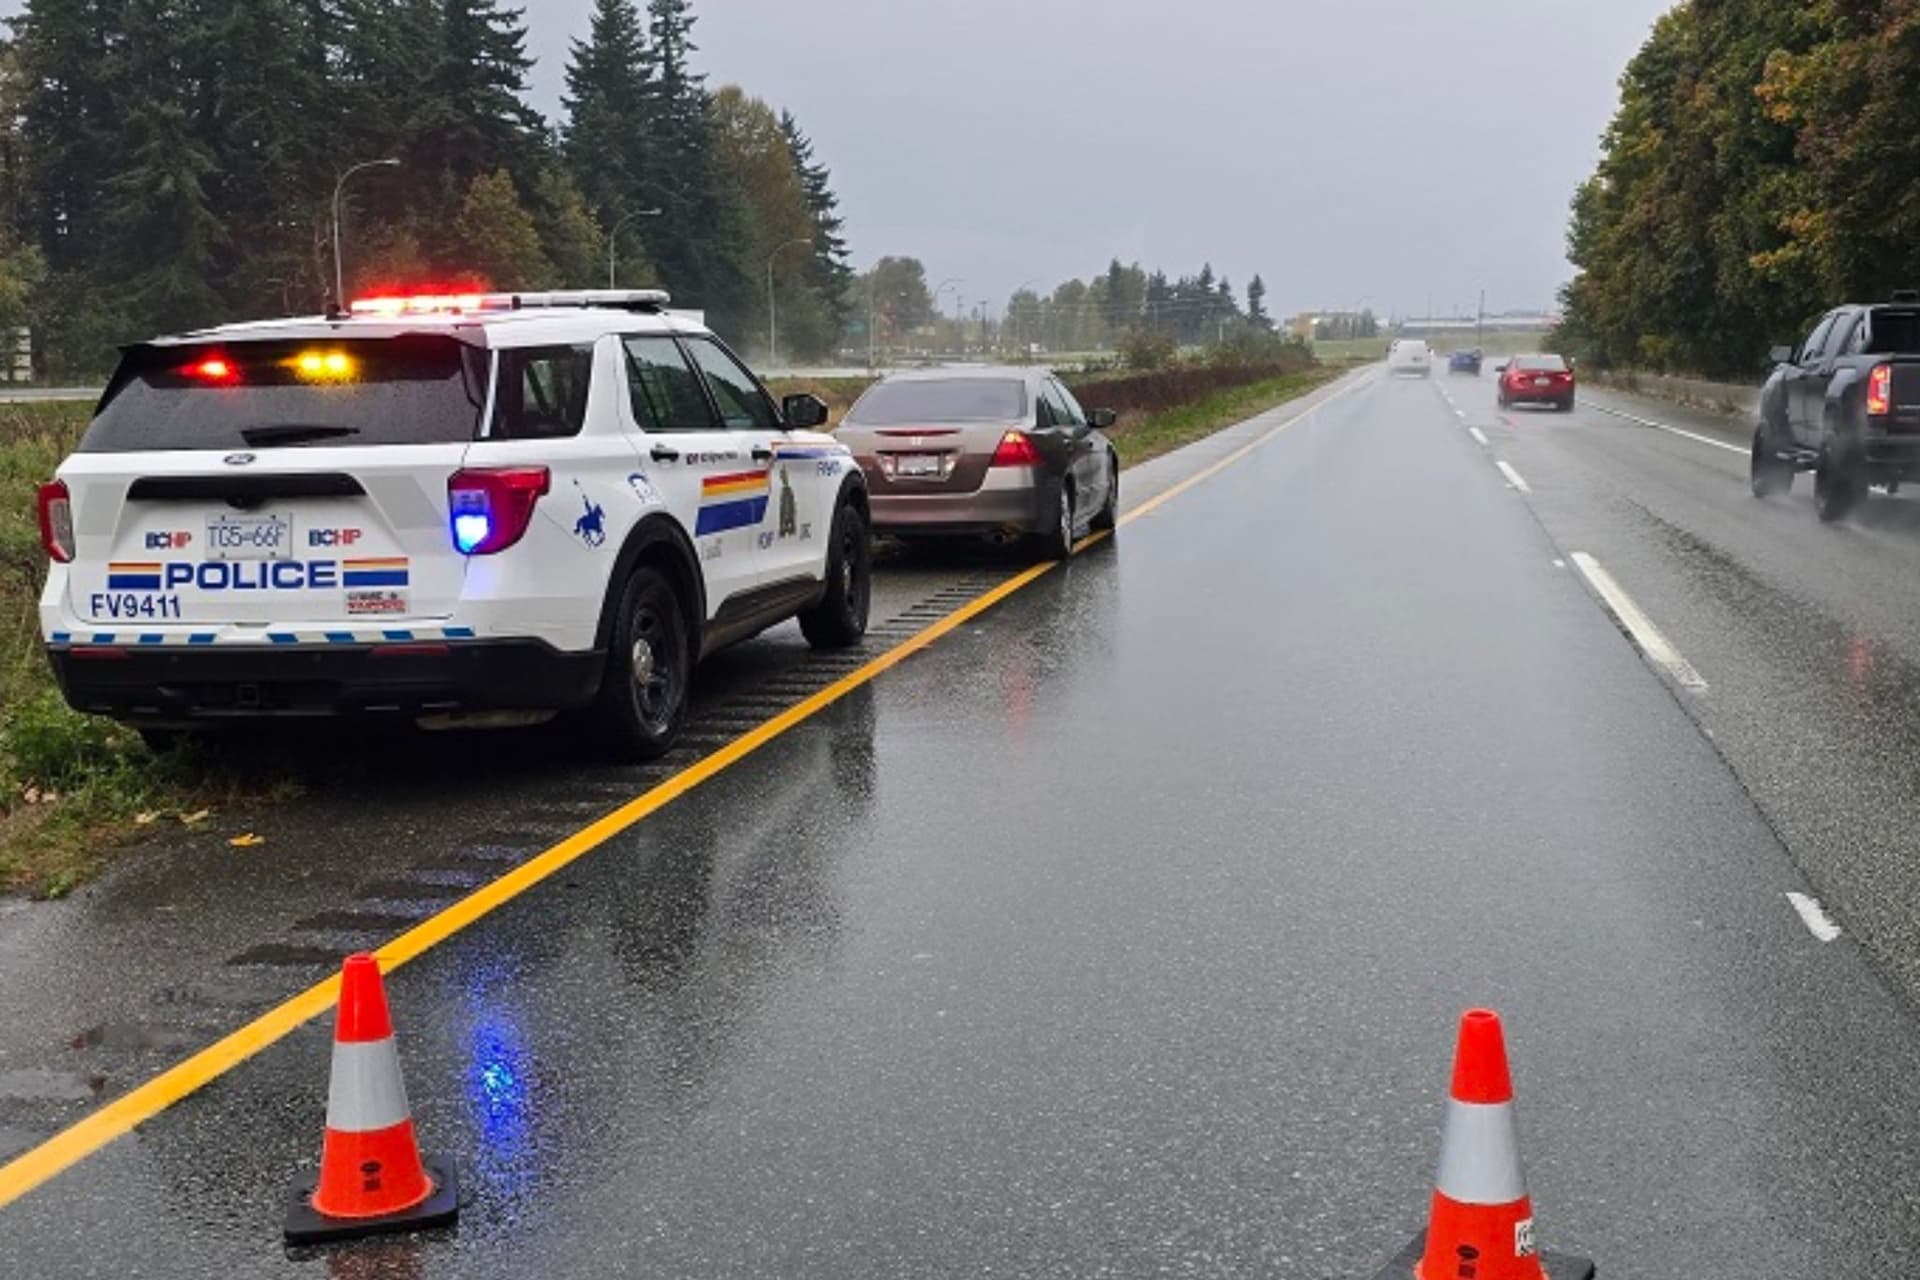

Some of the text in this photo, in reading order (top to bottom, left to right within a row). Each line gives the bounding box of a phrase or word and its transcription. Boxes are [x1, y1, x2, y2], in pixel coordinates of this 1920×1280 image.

[145, 531, 192, 549] BCHP
[308, 529, 361, 546] BCHP
[165, 561, 338, 590] POLICE
[90, 593, 182, 618] FV9411
